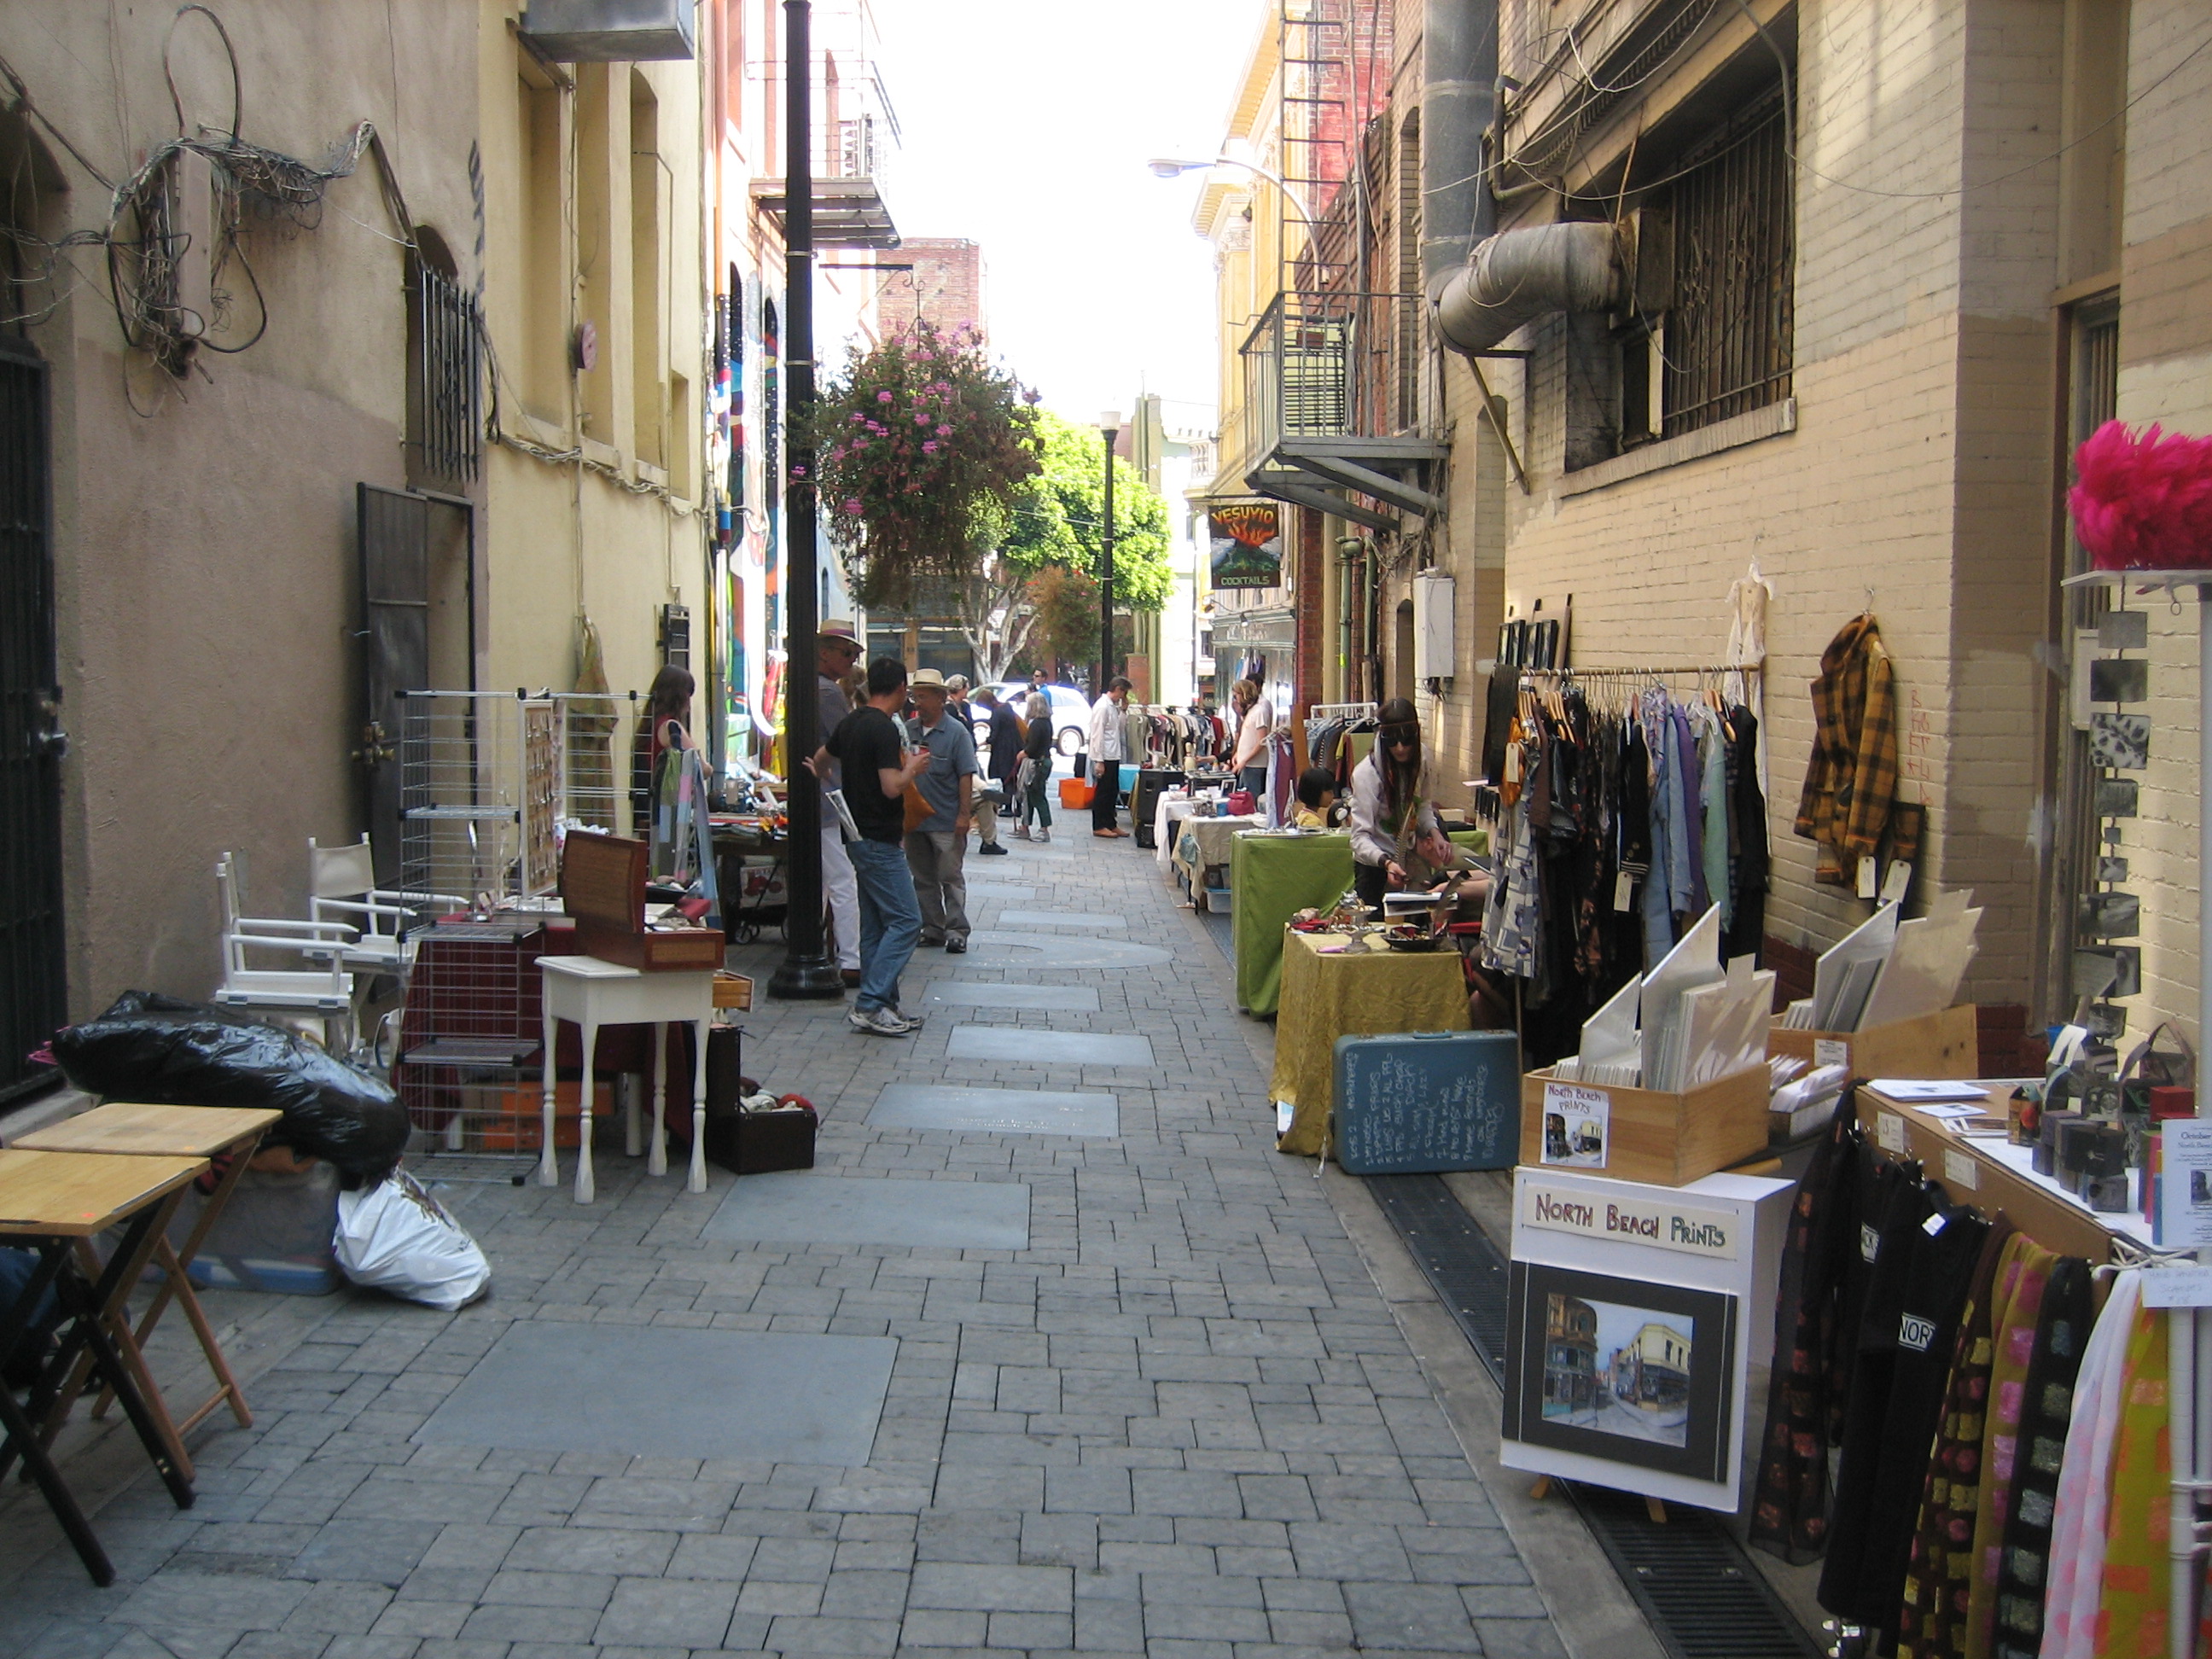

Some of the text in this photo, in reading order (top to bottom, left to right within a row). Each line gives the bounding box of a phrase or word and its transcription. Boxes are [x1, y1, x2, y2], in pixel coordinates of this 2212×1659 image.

[1211, 507, 1274, 524] VESUVIO
[1220, 576, 1270, 585] COCKTAILS
[1558, 1100, 1590, 1114] PRINTS
[1536, 1193, 1593, 1227] NORTH
[1606, 1204, 1660, 1239] BEACH
